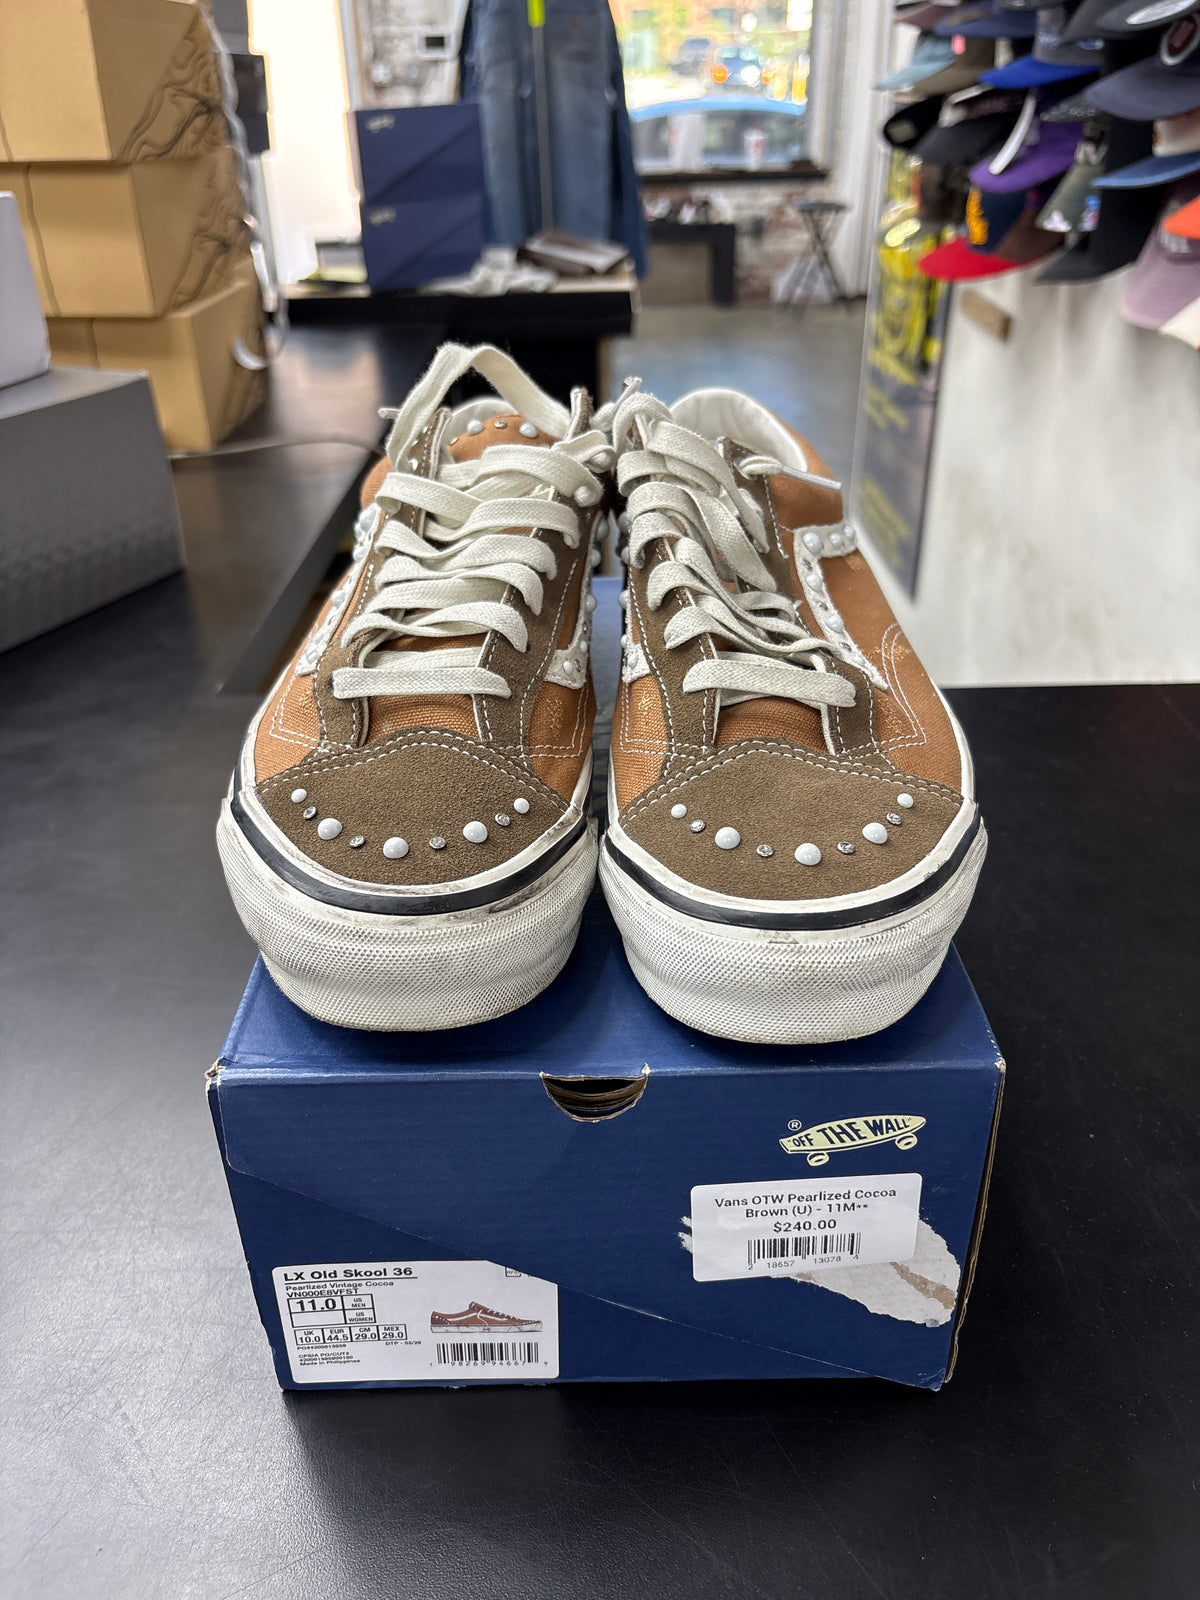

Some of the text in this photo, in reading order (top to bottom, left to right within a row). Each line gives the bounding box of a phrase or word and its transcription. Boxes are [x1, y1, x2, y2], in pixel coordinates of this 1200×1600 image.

[816, 1122, 867, 1145] THE
[714, 1189, 896, 1208] Vans OTW Pearlized Cocoa
[746, 1208, 788, 1218] Brown
[792, 1204, 813, 1217] (U)
[773, 1219, 837, 1233] $240.00
[767, 1260, 795, 1269] 18657
[814, 1256, 842, 1265] 13078
[284, 1267, 413, 1281] LX Old Skool 36
[285, 1283, 328, 1292] Pearlized
[329, 1282, 363, 1290] Vintage
[296, 1298, 337, 1312] 11.0
[326, 1334, 349, 1342] 44.5
[354, 1332, 377, 1340] 29.0
